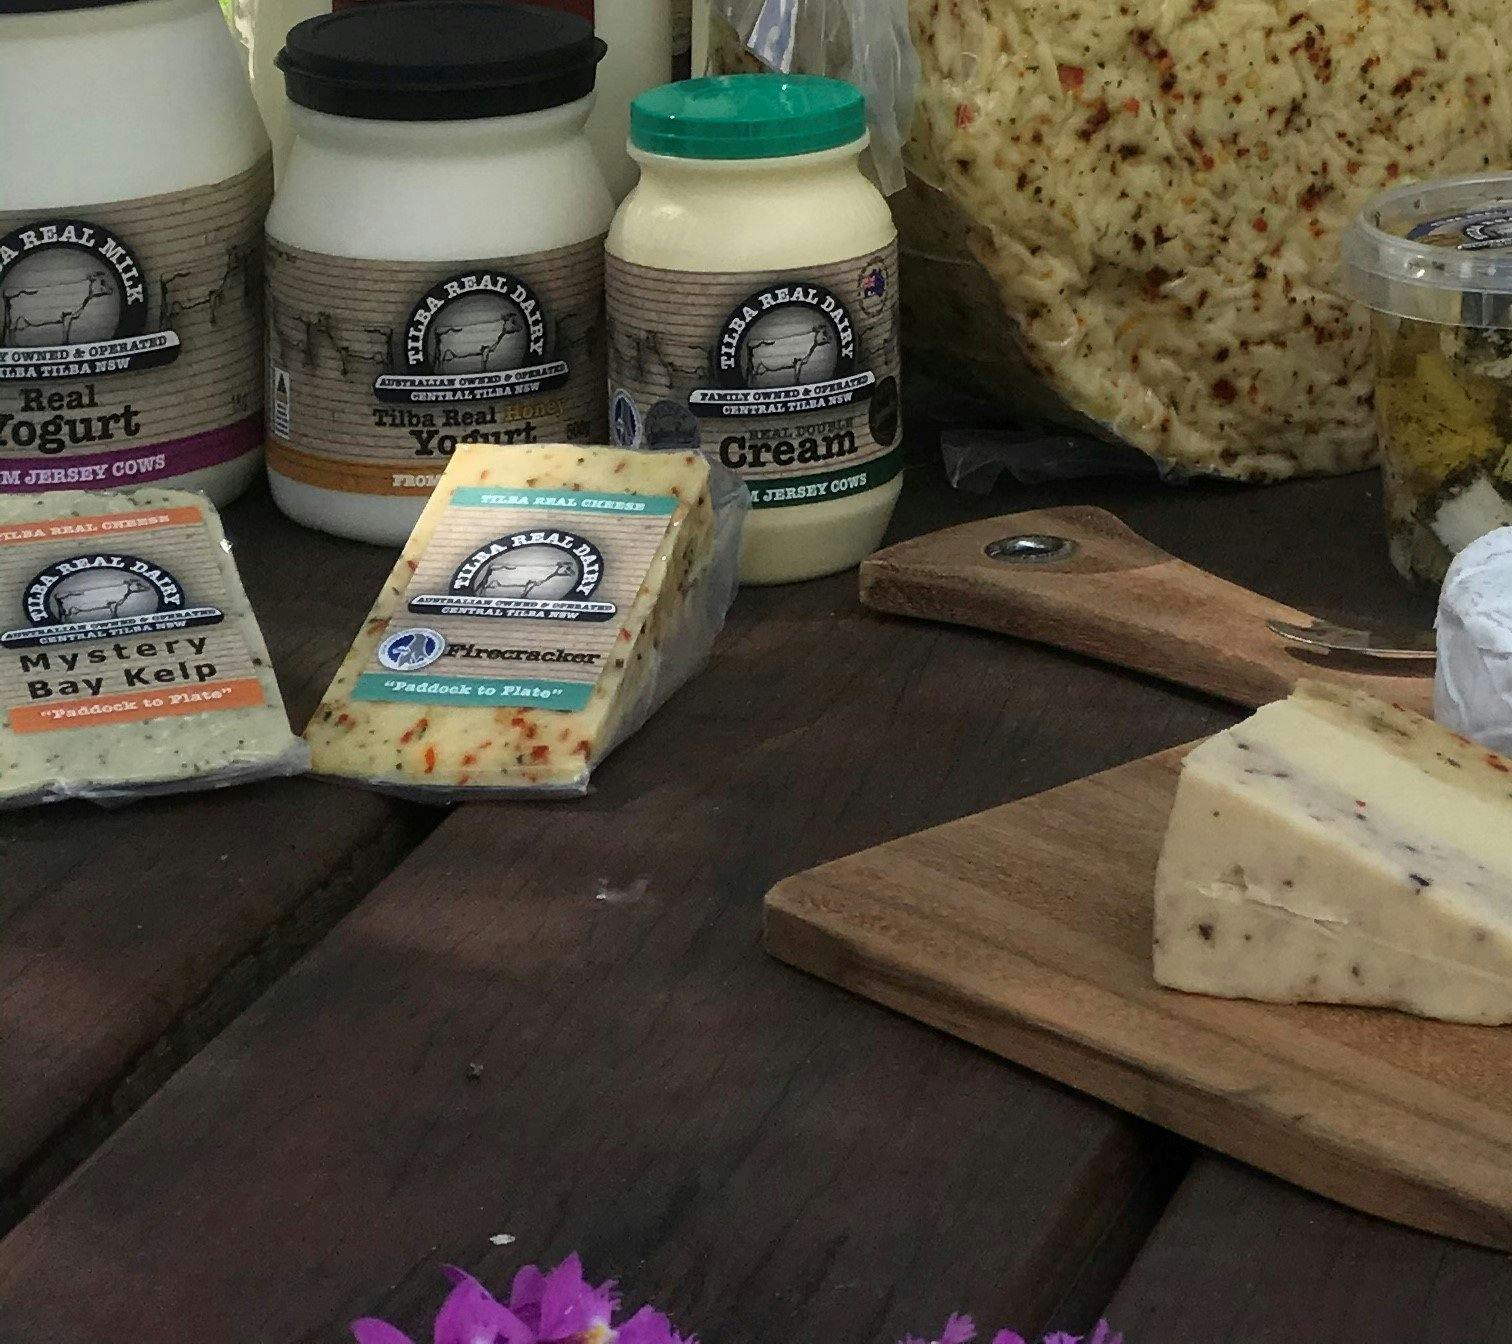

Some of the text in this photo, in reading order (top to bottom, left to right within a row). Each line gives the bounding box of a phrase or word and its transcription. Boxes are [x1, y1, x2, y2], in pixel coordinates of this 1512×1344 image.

[19, 225, 144, 305] REAL MILK
[407, 274, 545, 365] TILBA REAL DAIRY
[720, 305, 759, 370] TILBA
[758, 286, 819, 310] REAL
[820, 295, 854, 359] DAIRY
[11, 349, 69, 362] OWNED
[73, 347, 85, 359] &
[88, 335, 167, 357] OPERATED
[0, 358, 130, 378] ILBA TILBA NSW
[19, 383, 98, 413] Real
[411, 382, 541, 401] CENTRAL TILBA NSW
[700, 391, 751, 402] FAMILY
[753, 388, 799, 400] OWNED
[813, 374, 869, 396] OPERATED
[373, 408, 436, 428] Tilba
[441, 406, 498, 427] Real
[722, 392, 853, 416] CENTRAL TILBA NSW
[718, 430, 858, 470] Cream
[25, 462, 108, 485] JERSEY
[112, 453, 166, 476] COWS
[762, 481, 828, 503] JERSEY
[830, 472, 867, 492] COWS
[480, 494, 646, 511] TILBA REAL CHEESE
[49, 523, 98, 535] REAL
[453, 531, 600, 597] TILBA REAL DAIRY
[27, 555, 181, 622] TILBA REAL DAIRY
[441, 606, 503, 617] CENTRAL
[19, 636, 208, 673] Mystery
[445, 642, 602, 663] Firecracker
[27, 661, 218, 700] Bay Kelp
[477, 685, 497, 696] to
[143, 694, 164, 708] to
